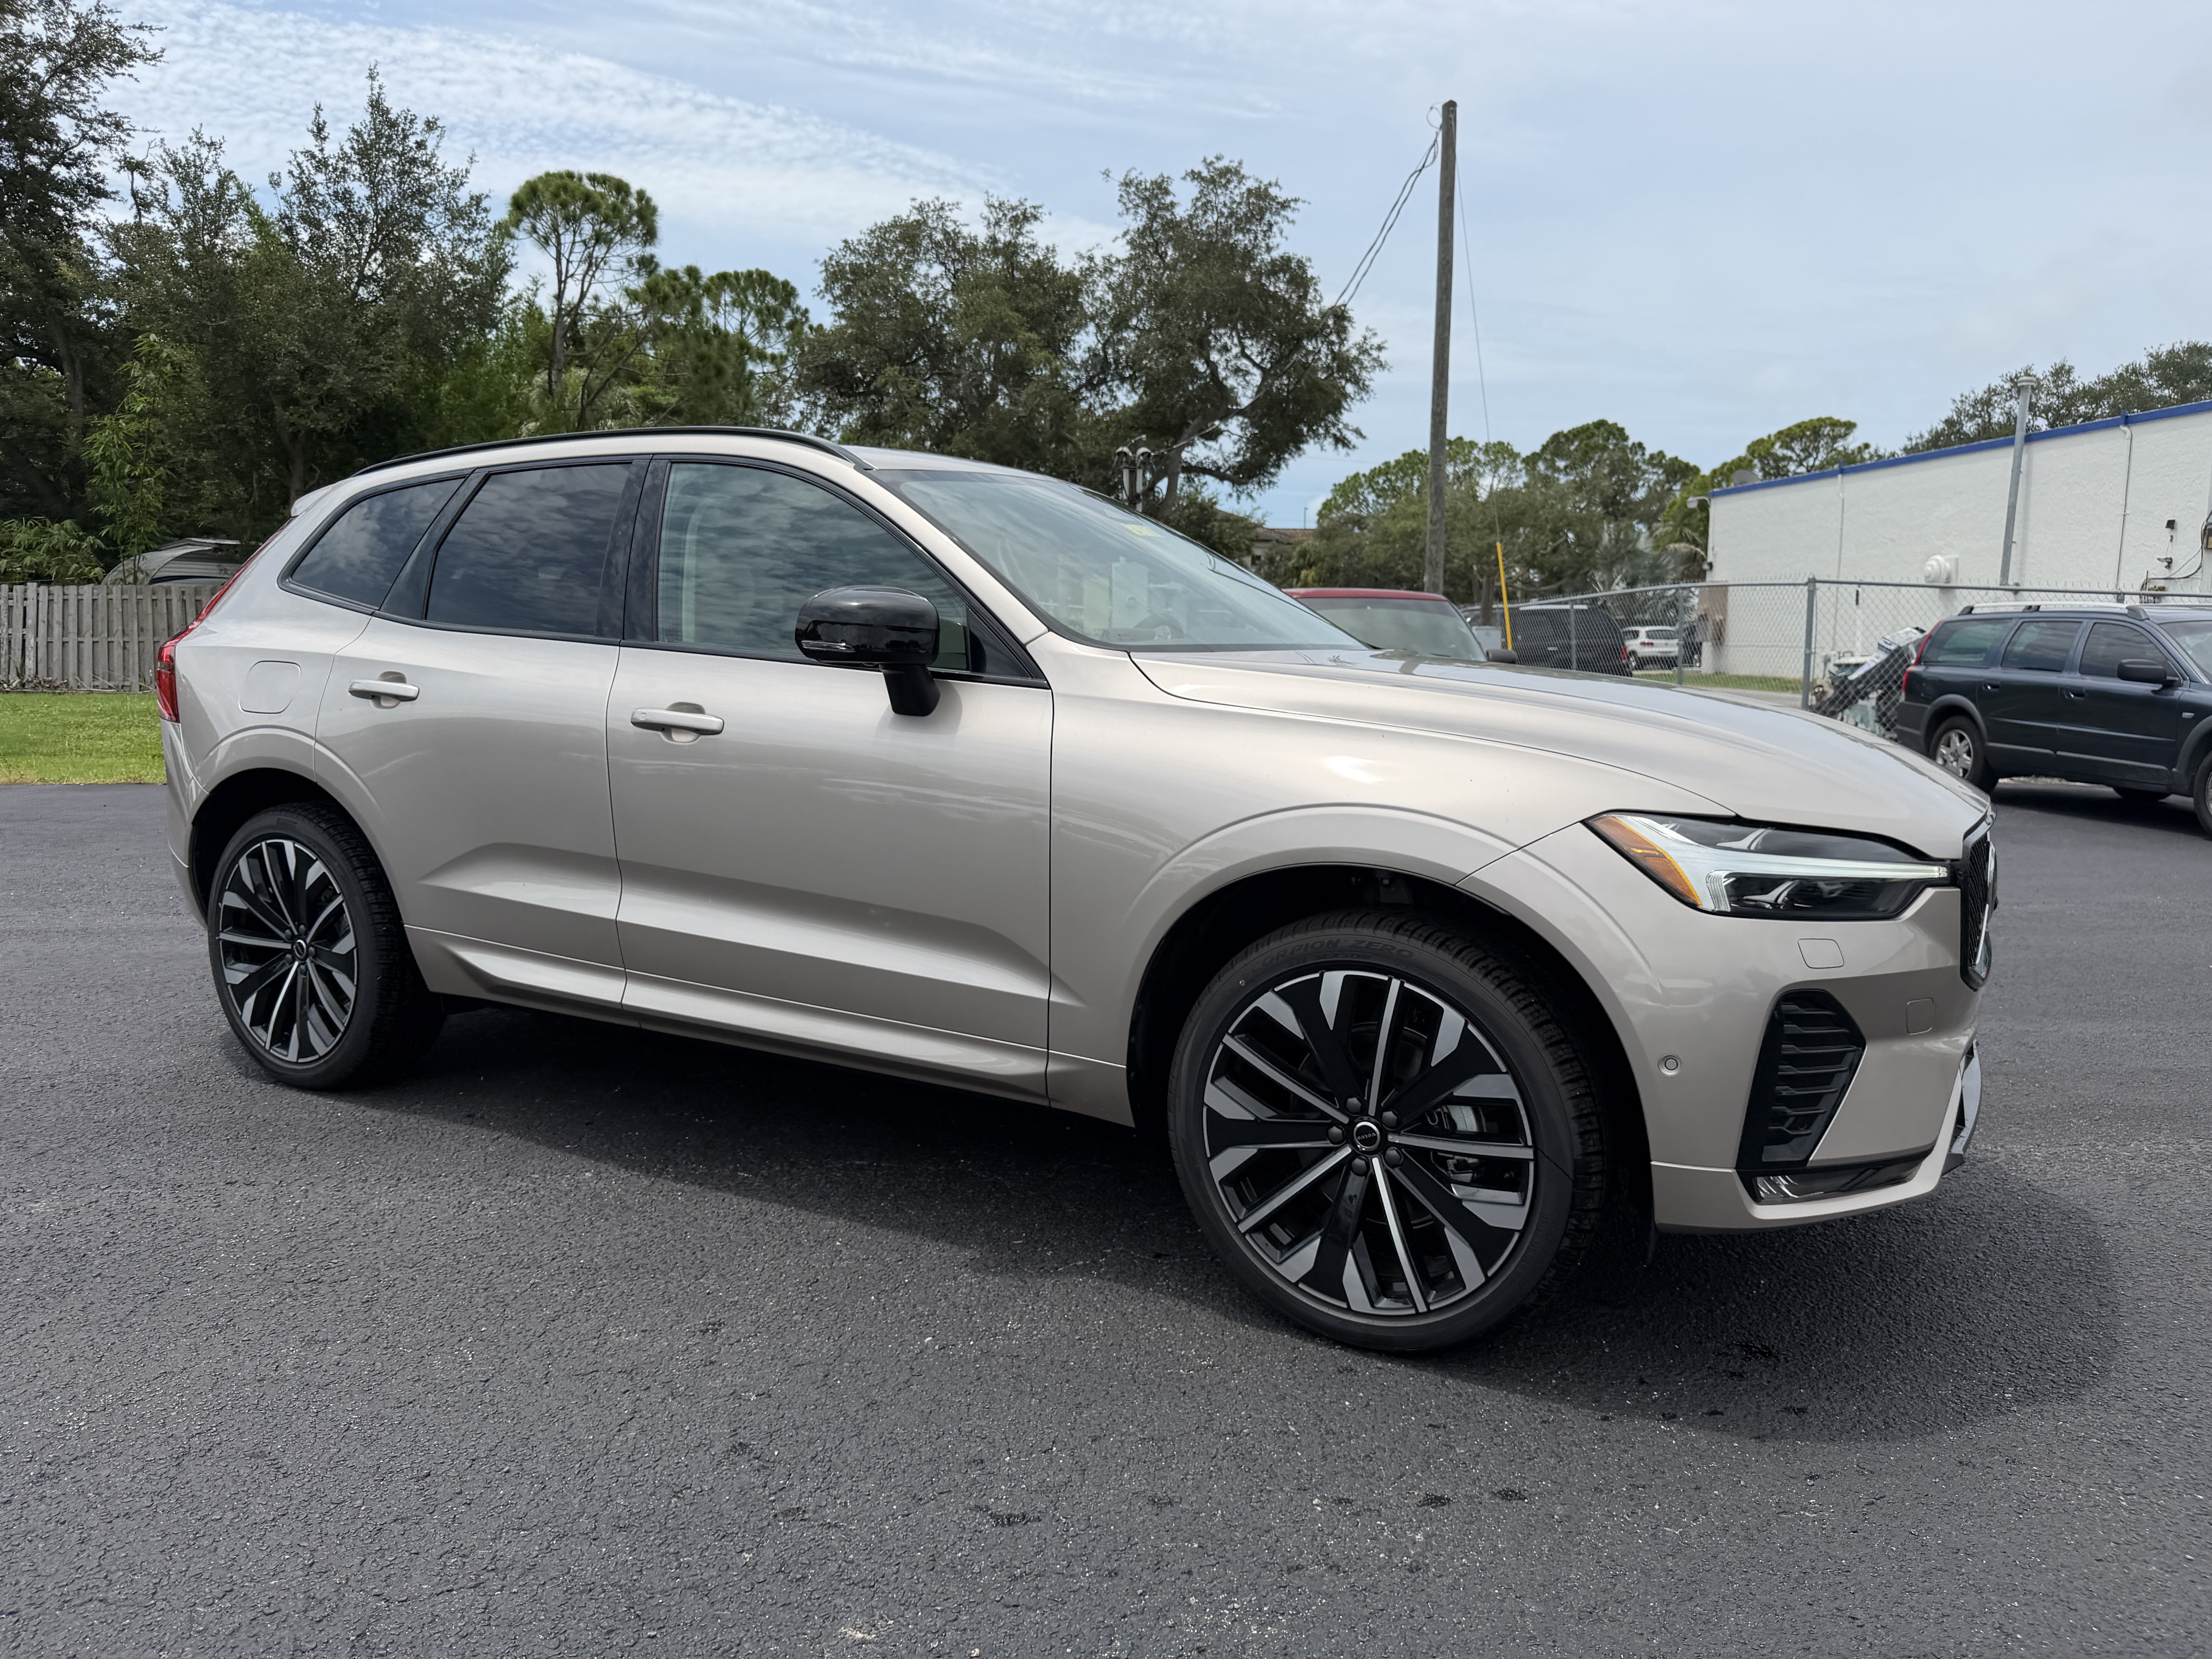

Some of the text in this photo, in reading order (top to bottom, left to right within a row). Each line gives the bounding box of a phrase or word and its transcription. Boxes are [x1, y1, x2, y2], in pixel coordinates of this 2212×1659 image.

[1240, 939, 1414, 979] SCORPION ZERO
[1313, 951, 1372, 960] SEASON
[1357, 1132, 1376, 1140] VOLVO
